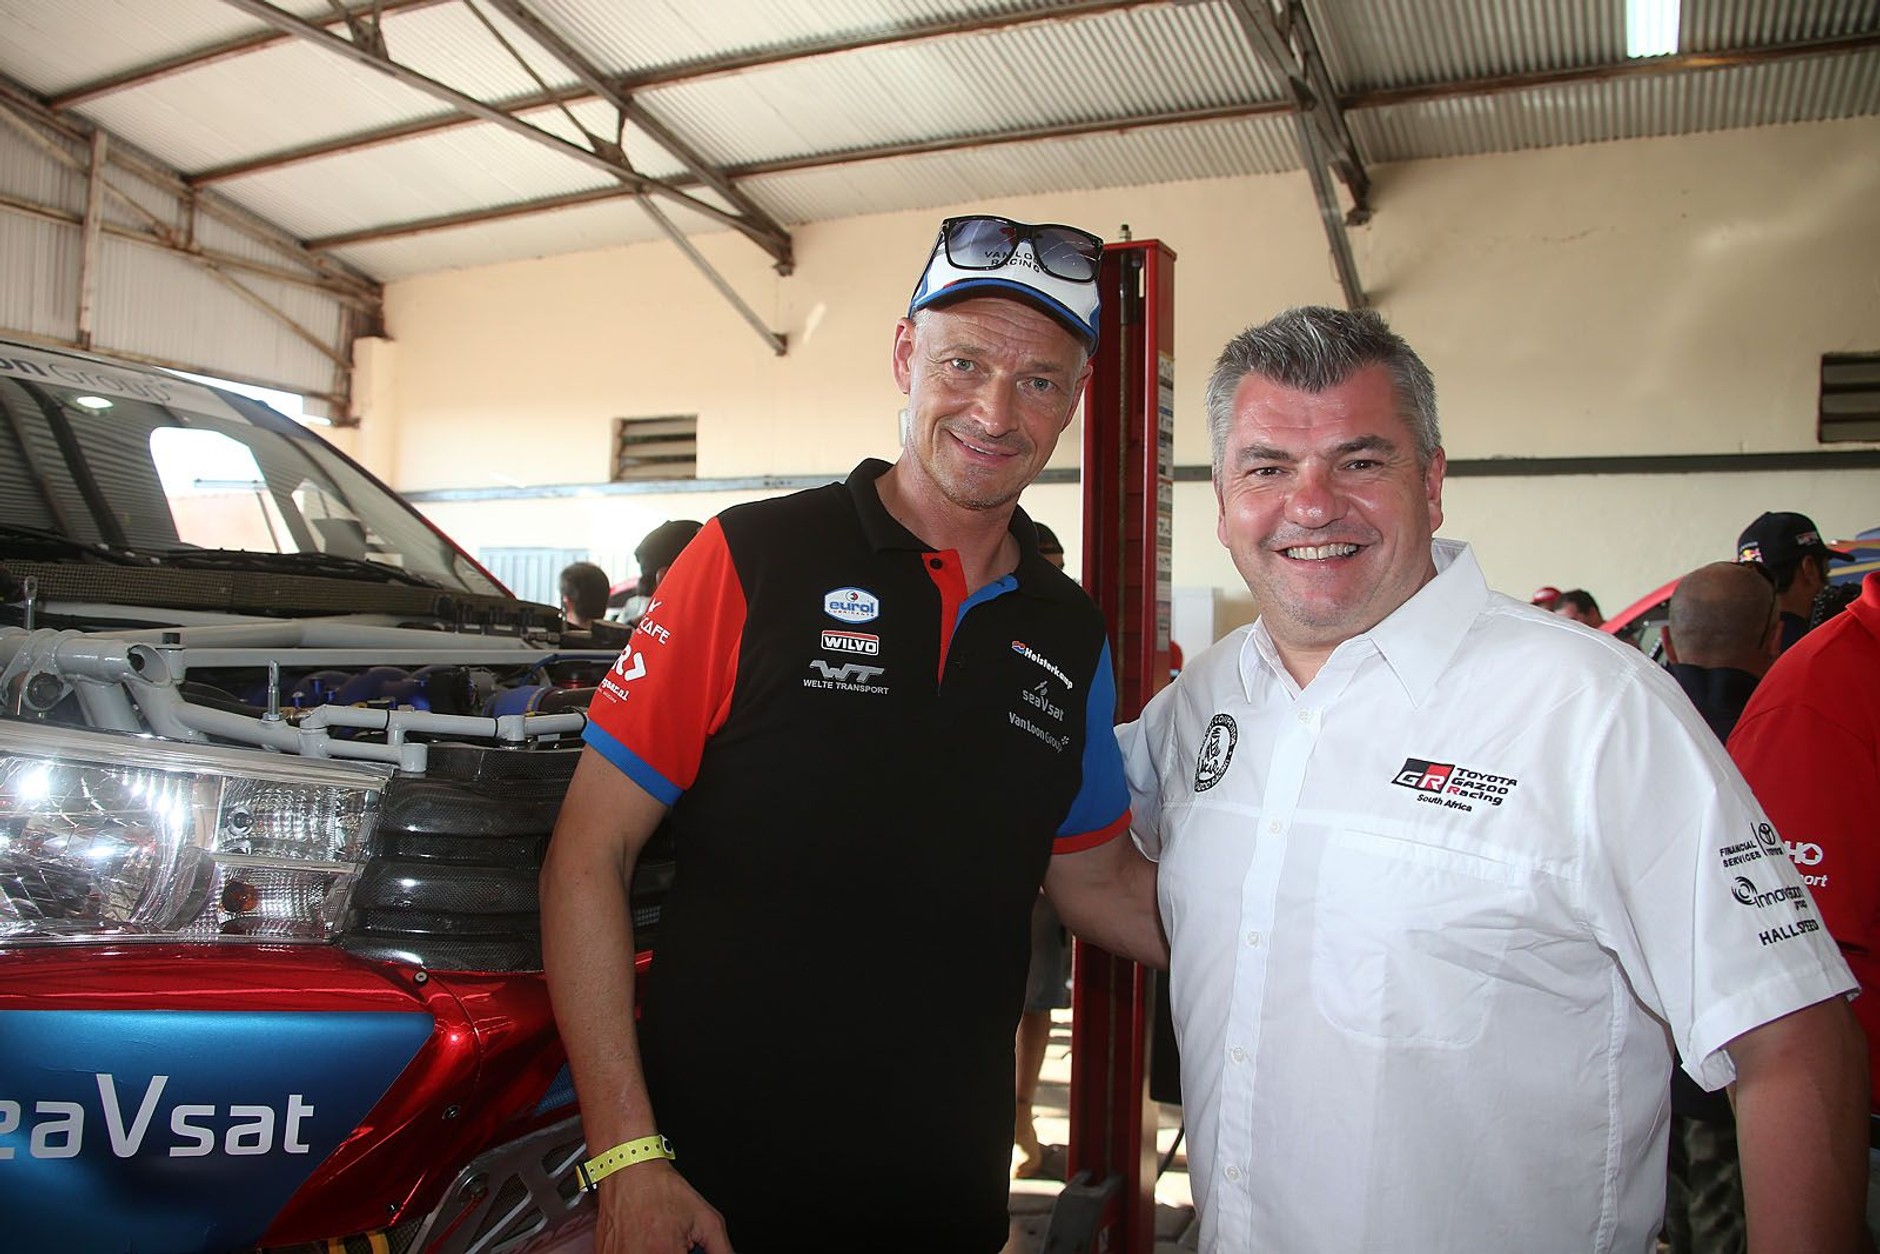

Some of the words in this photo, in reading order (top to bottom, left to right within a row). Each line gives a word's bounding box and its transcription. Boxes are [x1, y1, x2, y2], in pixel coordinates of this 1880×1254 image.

[991, 258, 1041, 273] RCING
[829, 600, 875, 613] eurol
[823, 635, 877, 654] WILVO
[803, 678, 834, 689] WELTE
[836, 682, 890, 695] TRANSPORT
[1022, 689, 1065, 722] seaVsat
[1396, 770, 1446, 791] GR
[1451, 777, 1509, 795] GAZOO
[1456, 767, 1518, 787] TOYOTA
[1416, 794, 1443, 806] South
[1444, 798, 1473, 812] Africa
[1446, 785, 1503, 807] Racing
[1720, 840, 1758, 857] FINANCIAL
[1723, 850, 1761, 868] SERVICES
[1800, 874, 1828, 888] ort
